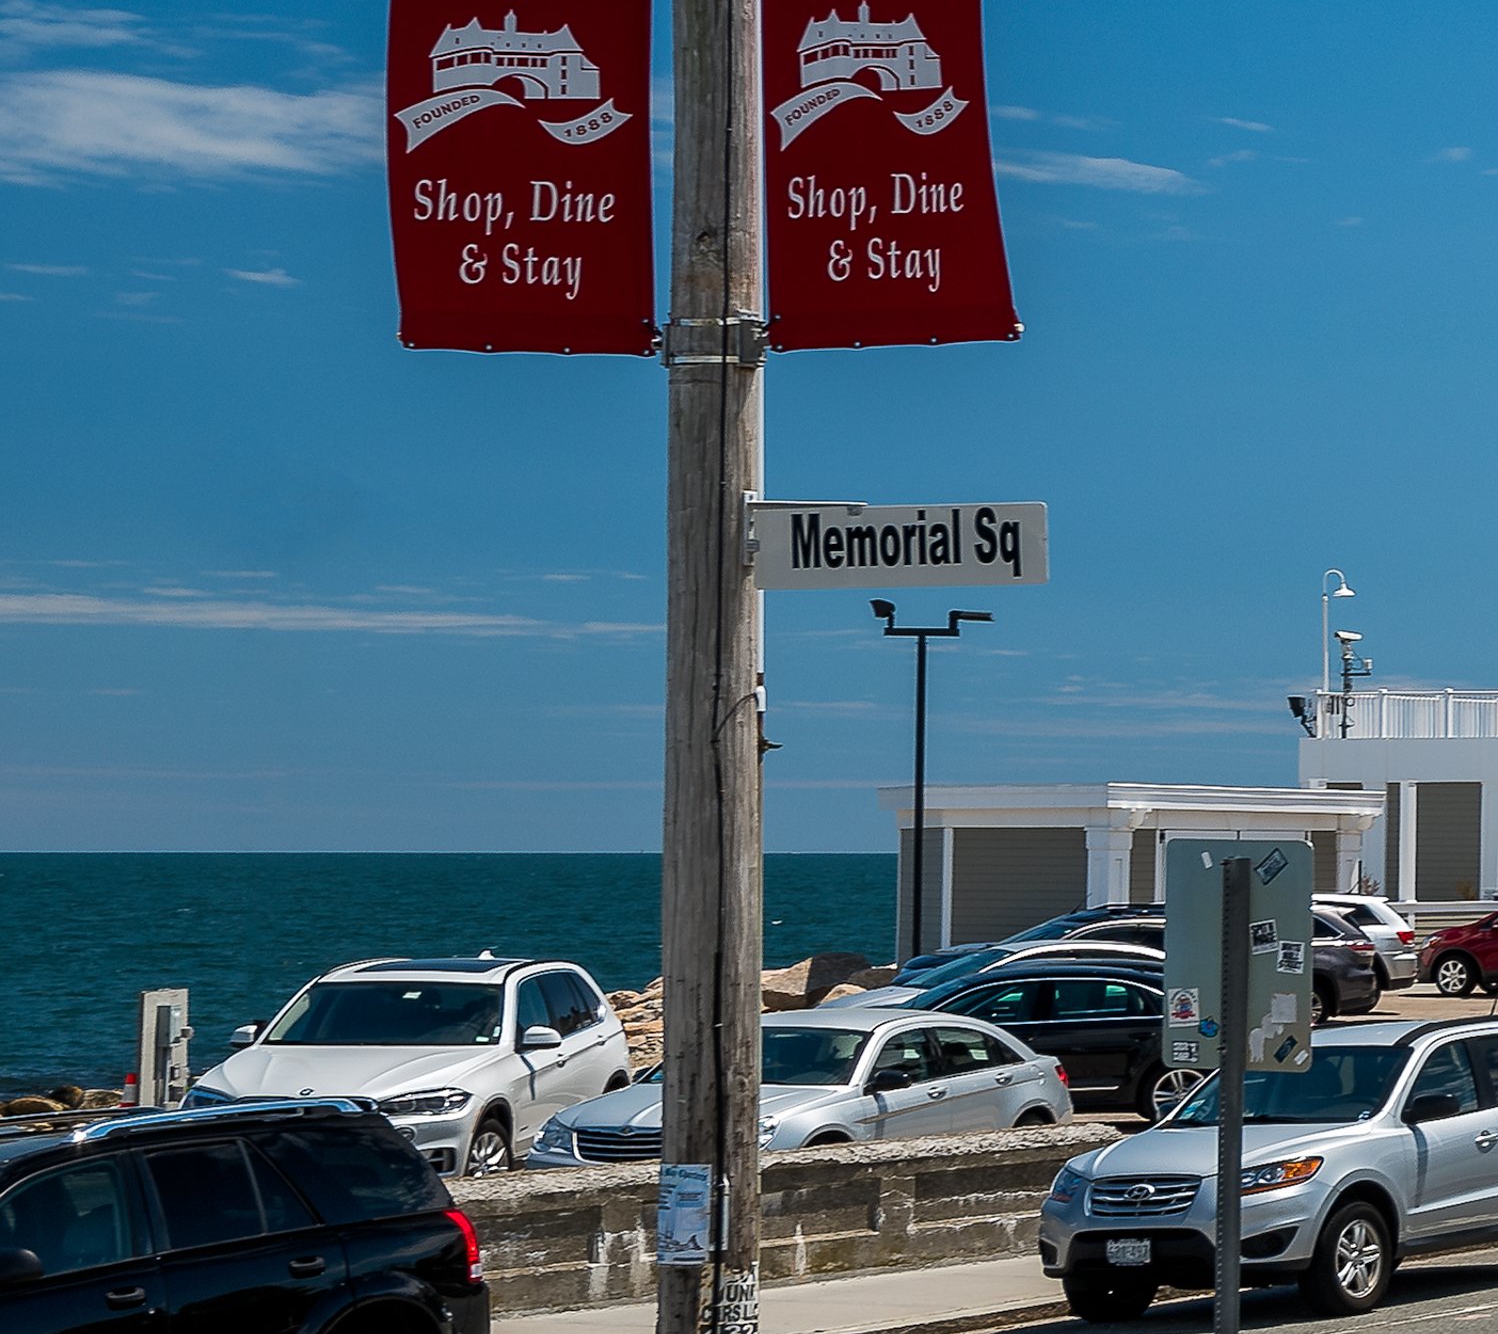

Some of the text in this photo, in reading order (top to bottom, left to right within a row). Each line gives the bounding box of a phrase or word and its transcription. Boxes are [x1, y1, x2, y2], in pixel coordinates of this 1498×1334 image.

[411, 94, 481, 130] FOUNDED
[563, 112, 614, 138] 1888
[784, 88, 841, 127] FOUNDED
[915, 100, 954, 129] 1888
[413, 178, 616, 236] Shop, Dine
[787, 171, 965, 231] Shop, Dine
[458, 242, 583, 300] & Stay
[827, 237, 941, 293] & Stay
[790, 506, 1022, 578] Memorial Sq
